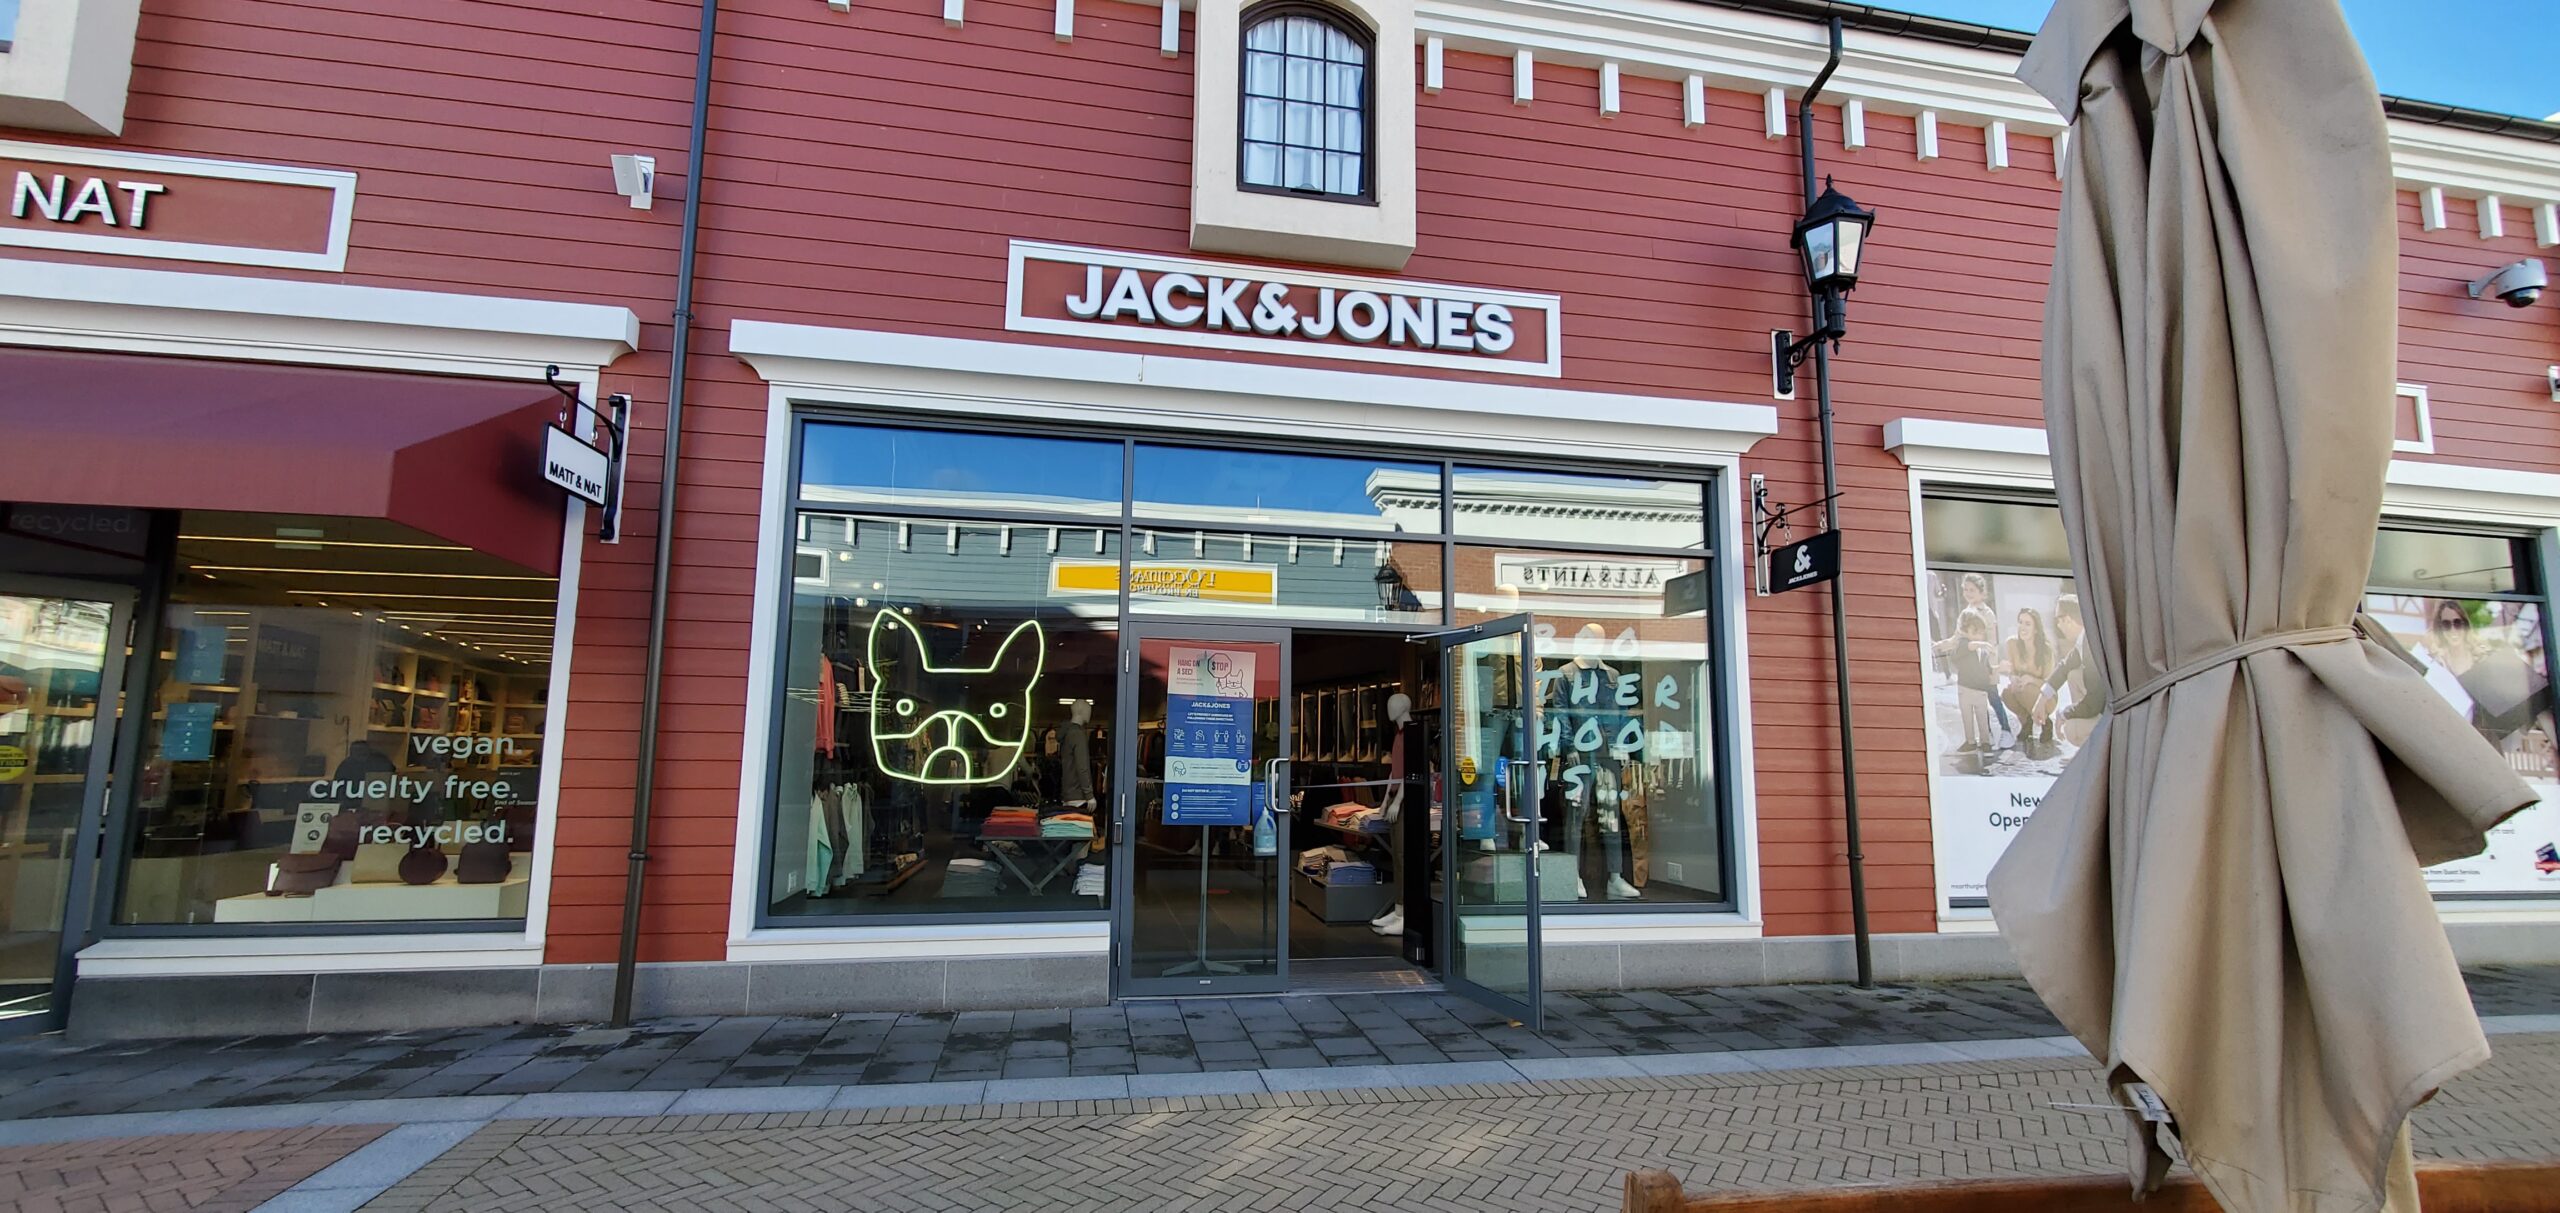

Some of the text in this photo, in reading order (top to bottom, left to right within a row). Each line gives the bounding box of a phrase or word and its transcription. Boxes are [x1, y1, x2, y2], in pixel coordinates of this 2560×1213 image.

[11, 171, 164, 228] NAT
[1065, 264, 1516, 355] JACK&JONES
[549, 461, 602, 498] MATT & NAT
[1212, 661, 1228, 671] STOP
[413, 736, 522, 758] vegan.
[310, 775, 518, 803] cruelty free.
[359, 820, 513, 848] recycled.
